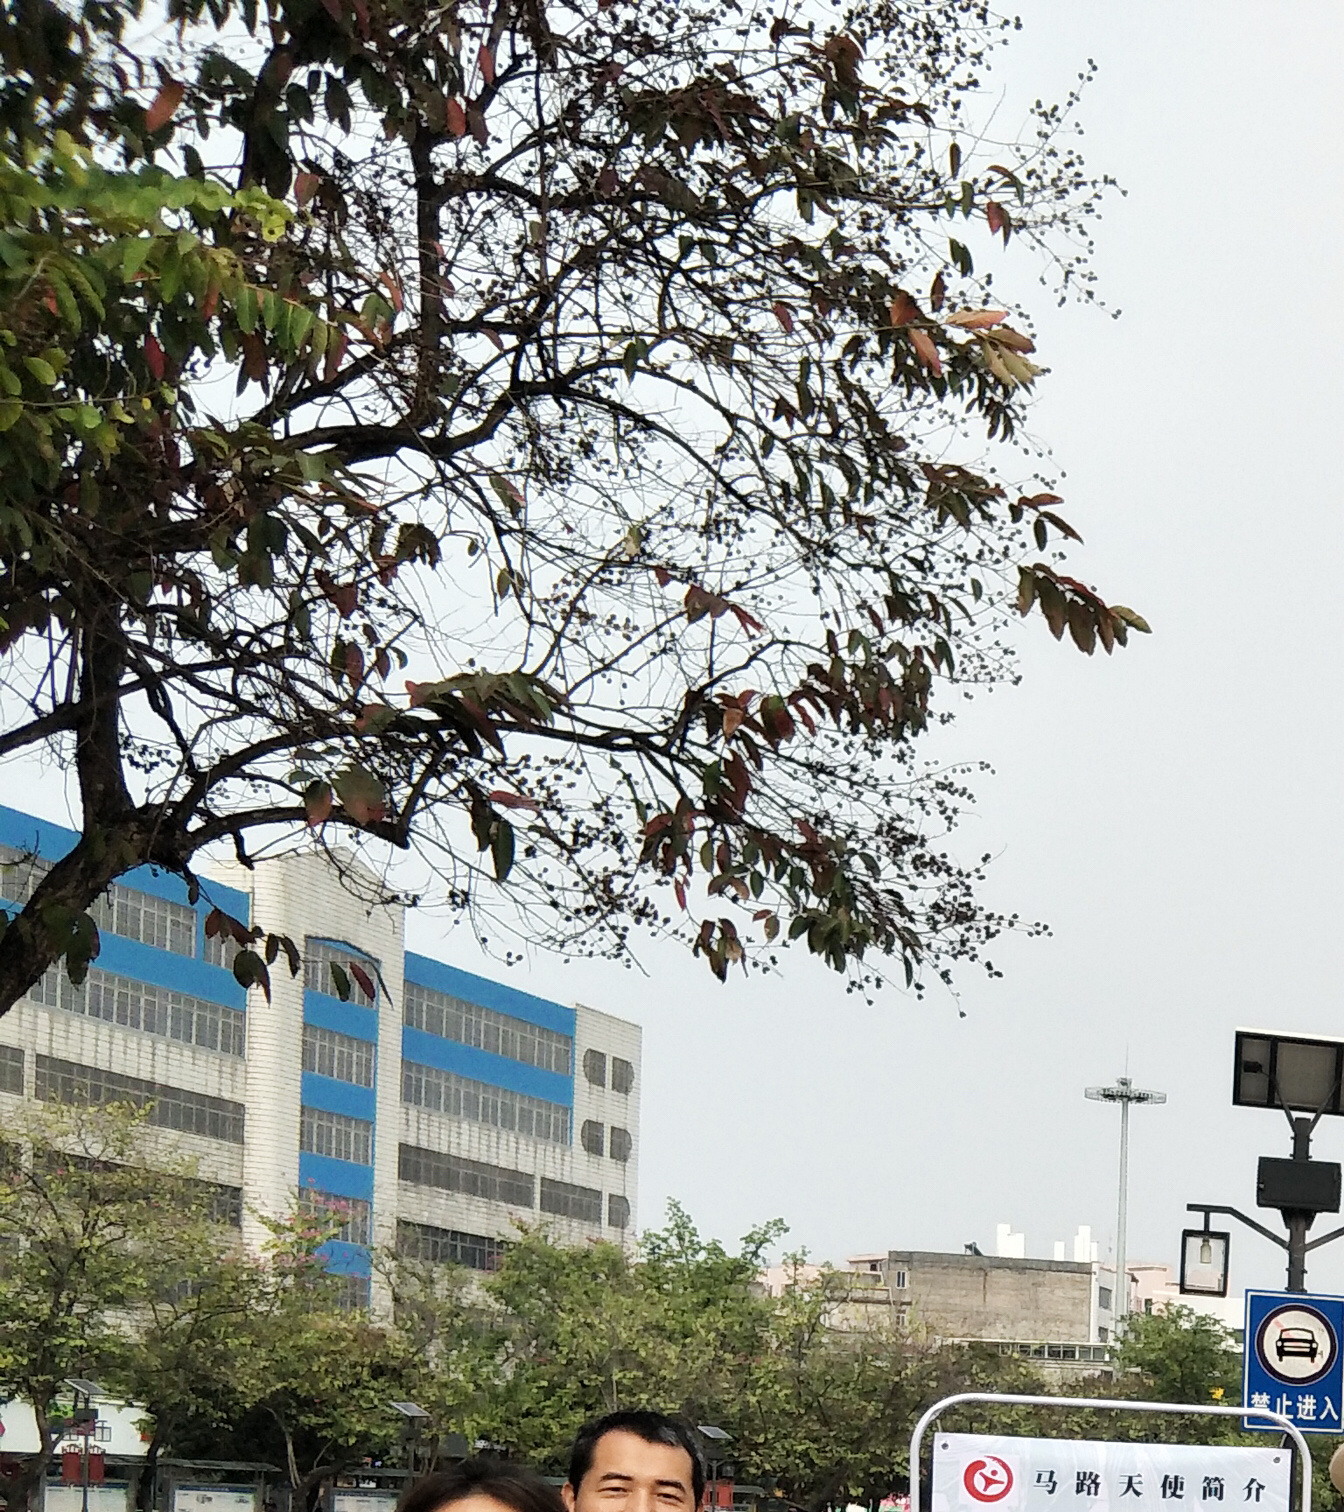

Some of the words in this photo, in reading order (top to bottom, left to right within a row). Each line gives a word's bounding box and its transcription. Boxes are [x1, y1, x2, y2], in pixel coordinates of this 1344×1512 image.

[1250, 1392, 1339, 1421] 禁止进入
[1033, 1468, 1266, 1503] 马路天使简介
